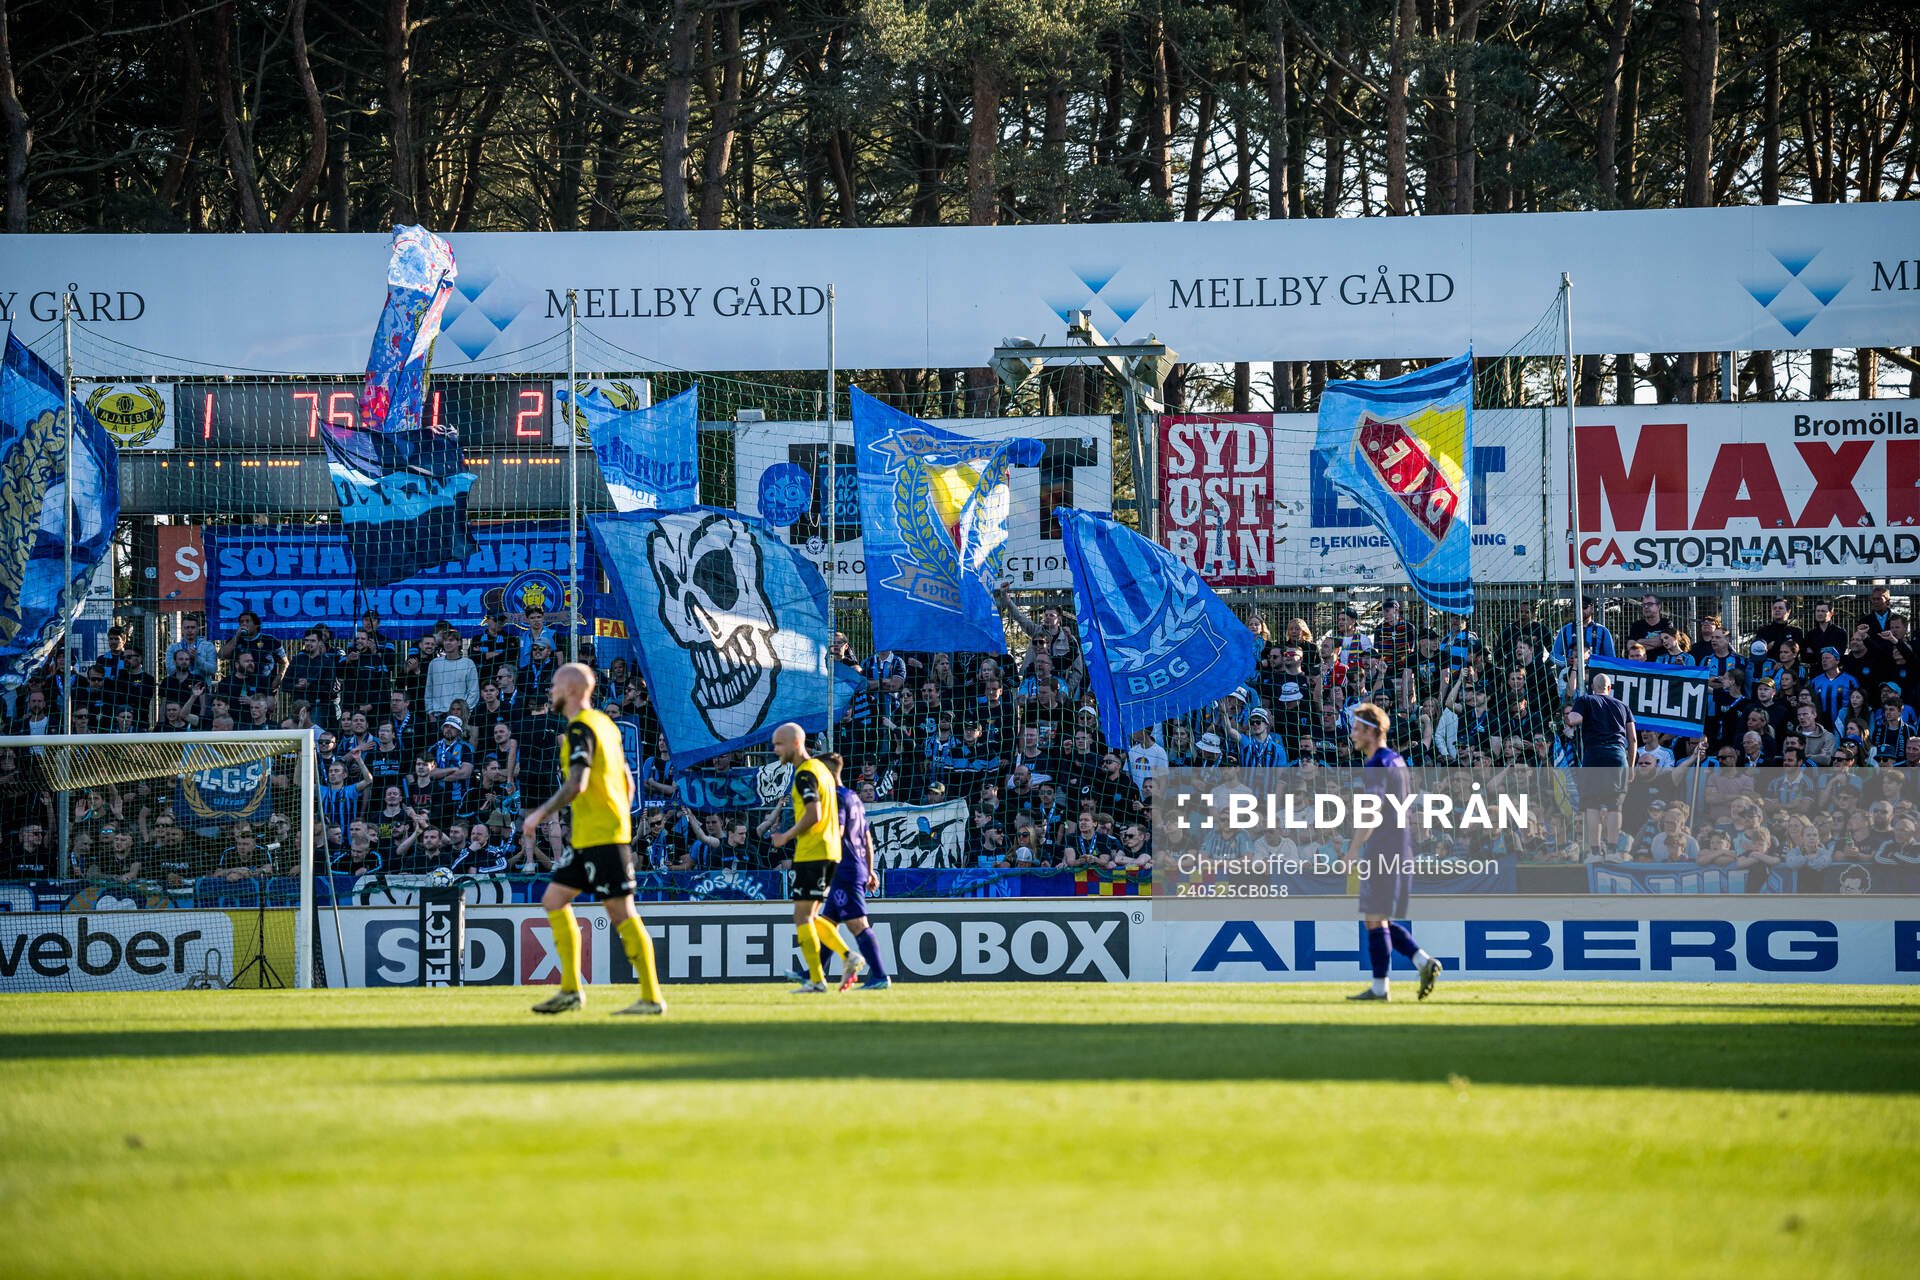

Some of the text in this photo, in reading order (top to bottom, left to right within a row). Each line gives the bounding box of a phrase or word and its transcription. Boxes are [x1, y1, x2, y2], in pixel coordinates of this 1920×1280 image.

[30, 282, 145, 321] GÅRD
[544, 277, 825, 318] MELLBY GÅRD
[1169, 264, 1455, 308] MELLBY GÅRD
[516, 391, 544, 436] 2
[1795, 412, 1920, 436] Bromölla
[1168, 423, 1268, 473] SYD
[1167, 530, 1270, 577] RAN
[1472, 534, 1506, 546] NING
[1634, 533, 1920, 569] STORMARKNAD
[219, 588, 482, 618] STOCKHOLM
[1127, 656, 1191, 695] BBG
